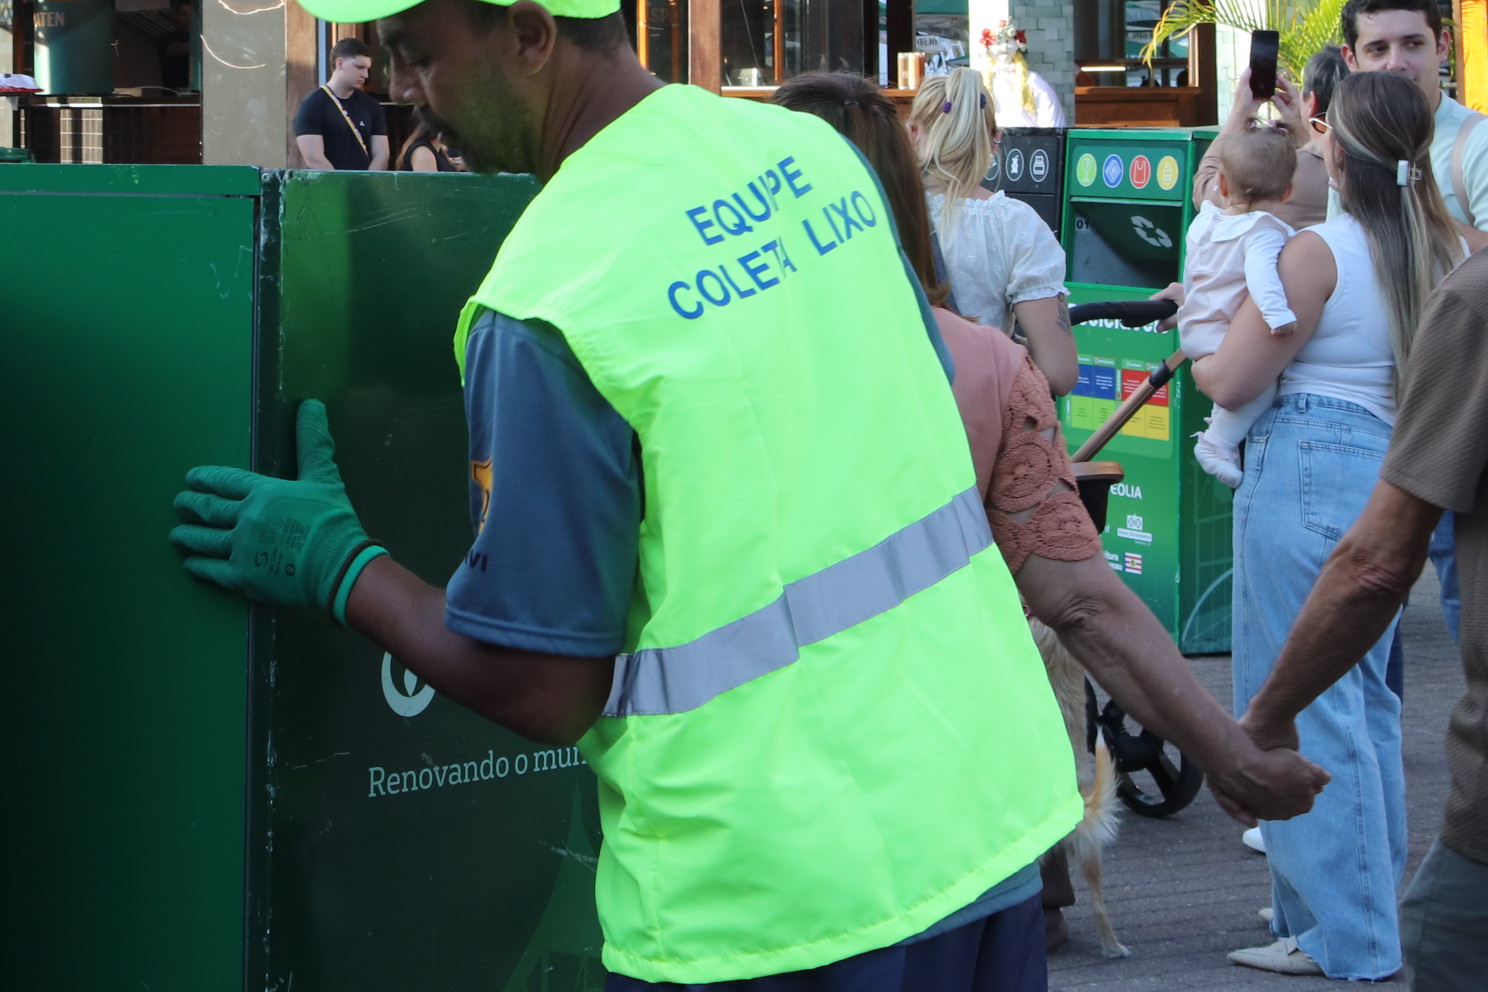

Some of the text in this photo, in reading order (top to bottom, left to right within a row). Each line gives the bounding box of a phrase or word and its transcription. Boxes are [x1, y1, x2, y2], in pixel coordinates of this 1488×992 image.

[33, 11, 65, 27] ATEN
[685, 156, 813, 246] EQUIPE
[667, 190, 877, 320] COLETA LIXO
[1110, 483, 1143, 499] EOLIA
[368, 745, 589, 798] Renovando o mun
